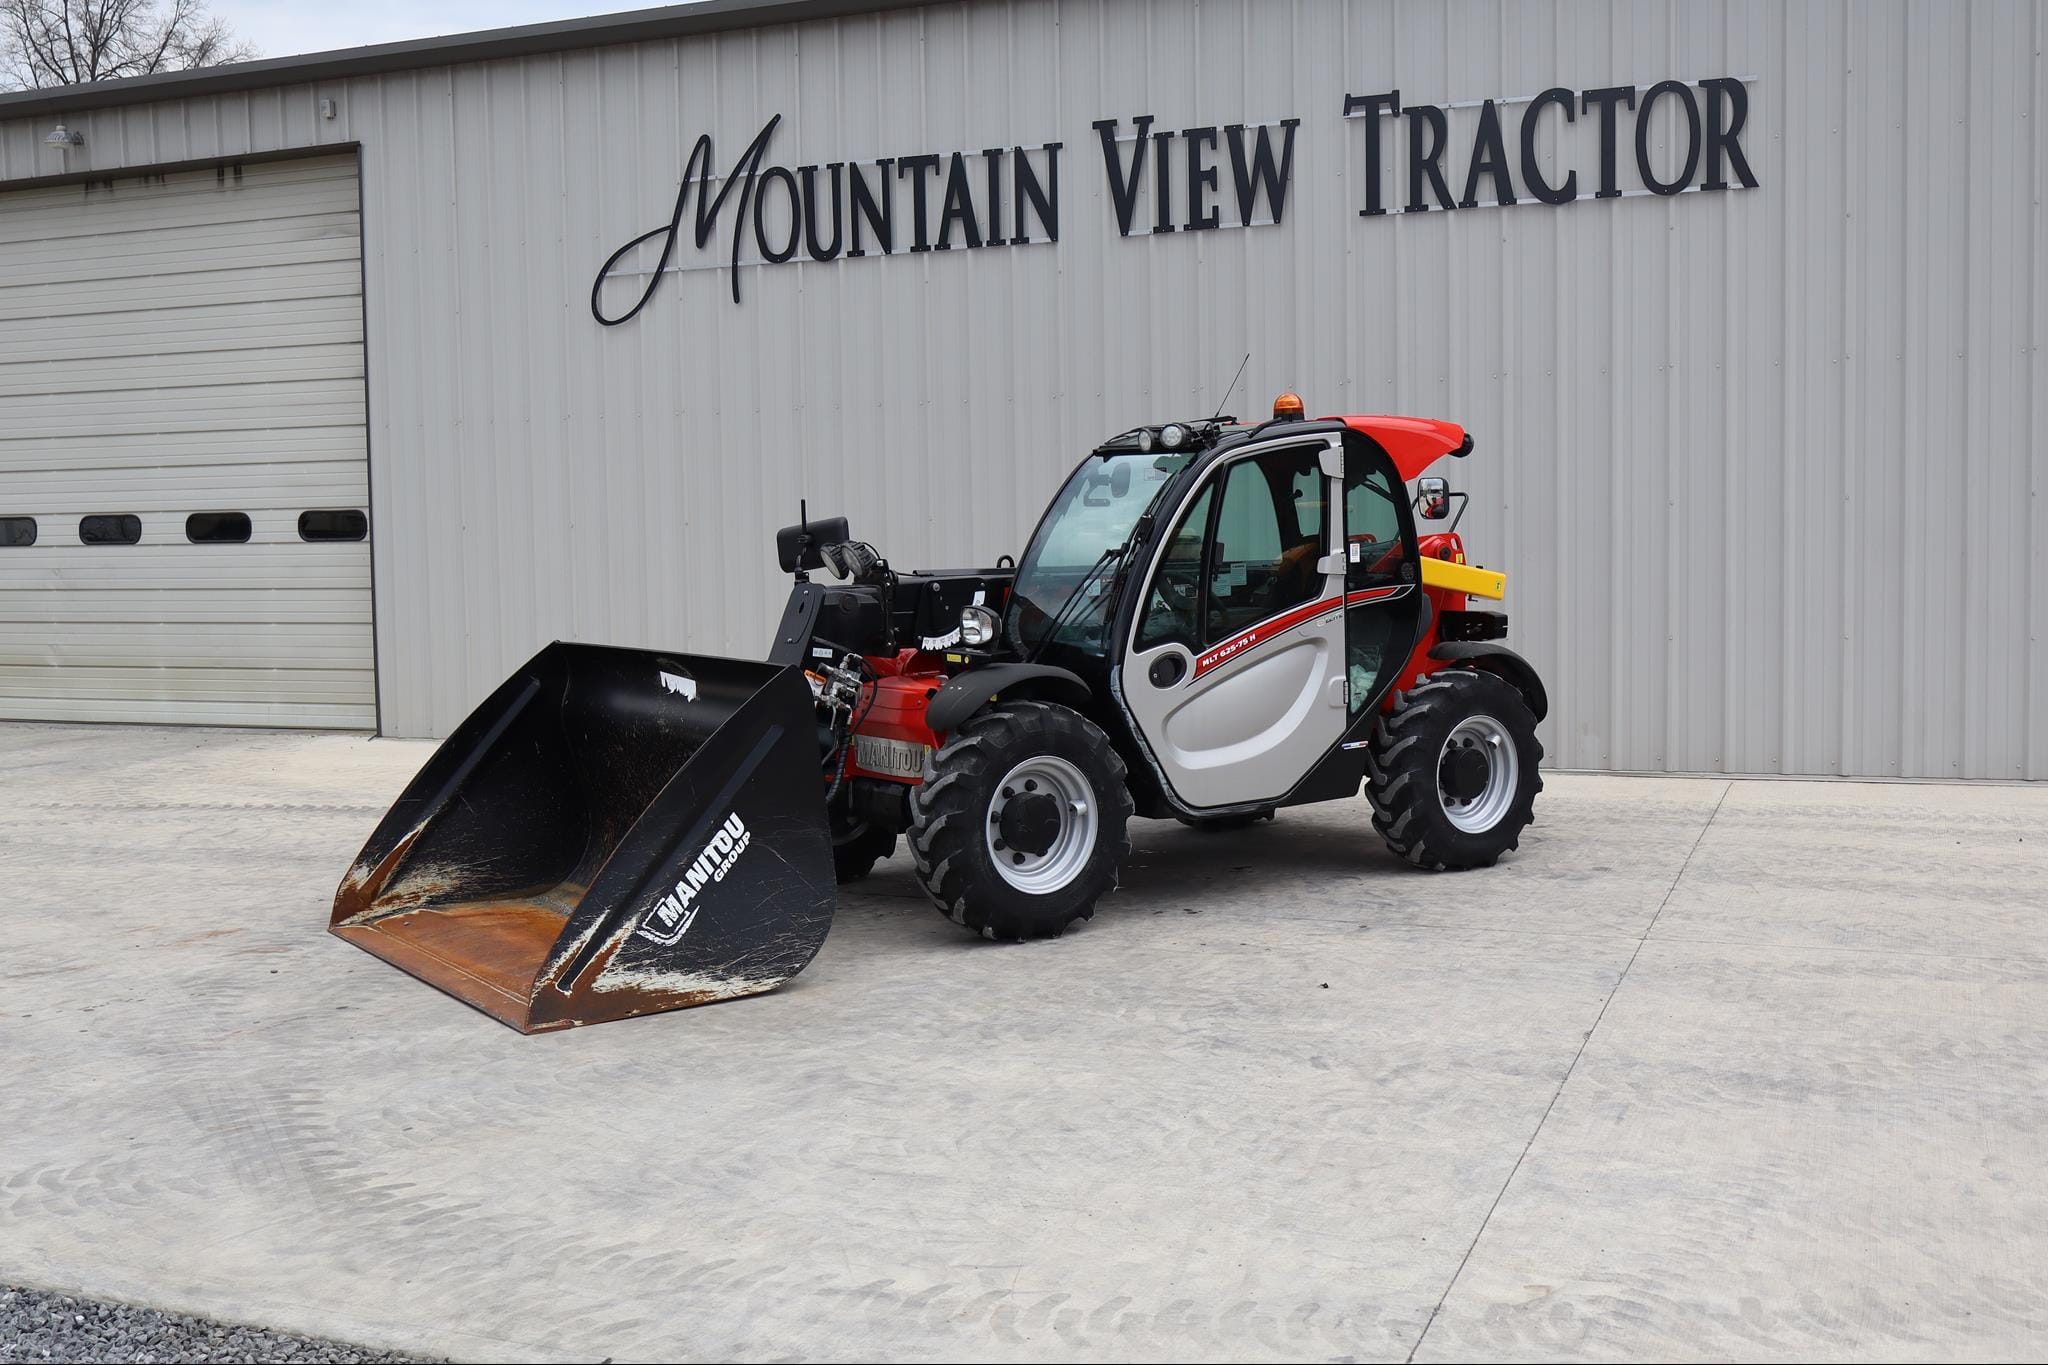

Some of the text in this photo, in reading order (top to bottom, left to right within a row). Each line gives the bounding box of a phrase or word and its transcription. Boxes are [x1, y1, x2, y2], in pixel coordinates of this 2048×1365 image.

[591, 77, 1760, 327] MOUNTAIN VIEW TRACTOR
[1202, 653, 1219, 667] MLT
[856, 740, 924, 773] MANITOU
[657, 811, 745, 928] MANITOU
[713, 831, 751, 883] GROUP
